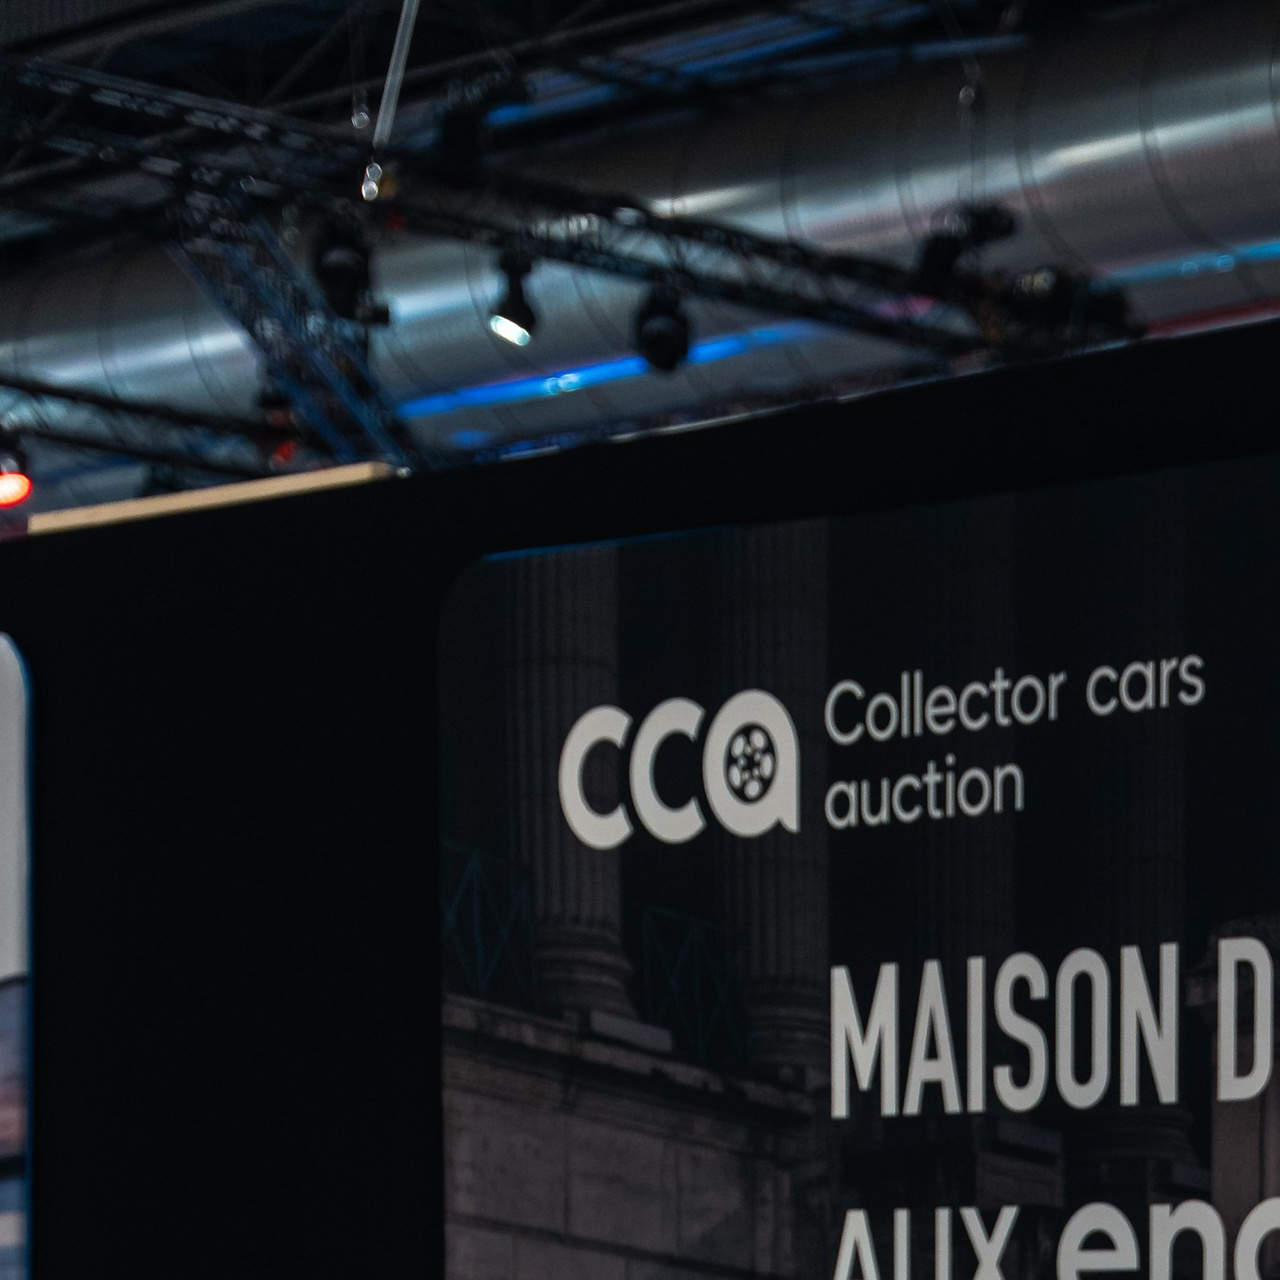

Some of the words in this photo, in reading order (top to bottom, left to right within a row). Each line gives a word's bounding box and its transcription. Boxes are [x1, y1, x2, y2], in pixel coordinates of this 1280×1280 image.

[825, 667, 1066, 745] Collector
[1086, 654, 1205, 716] cars
[824, 754, 1024, 829] auction
[831, 943, 1178, 1118] MAISON
